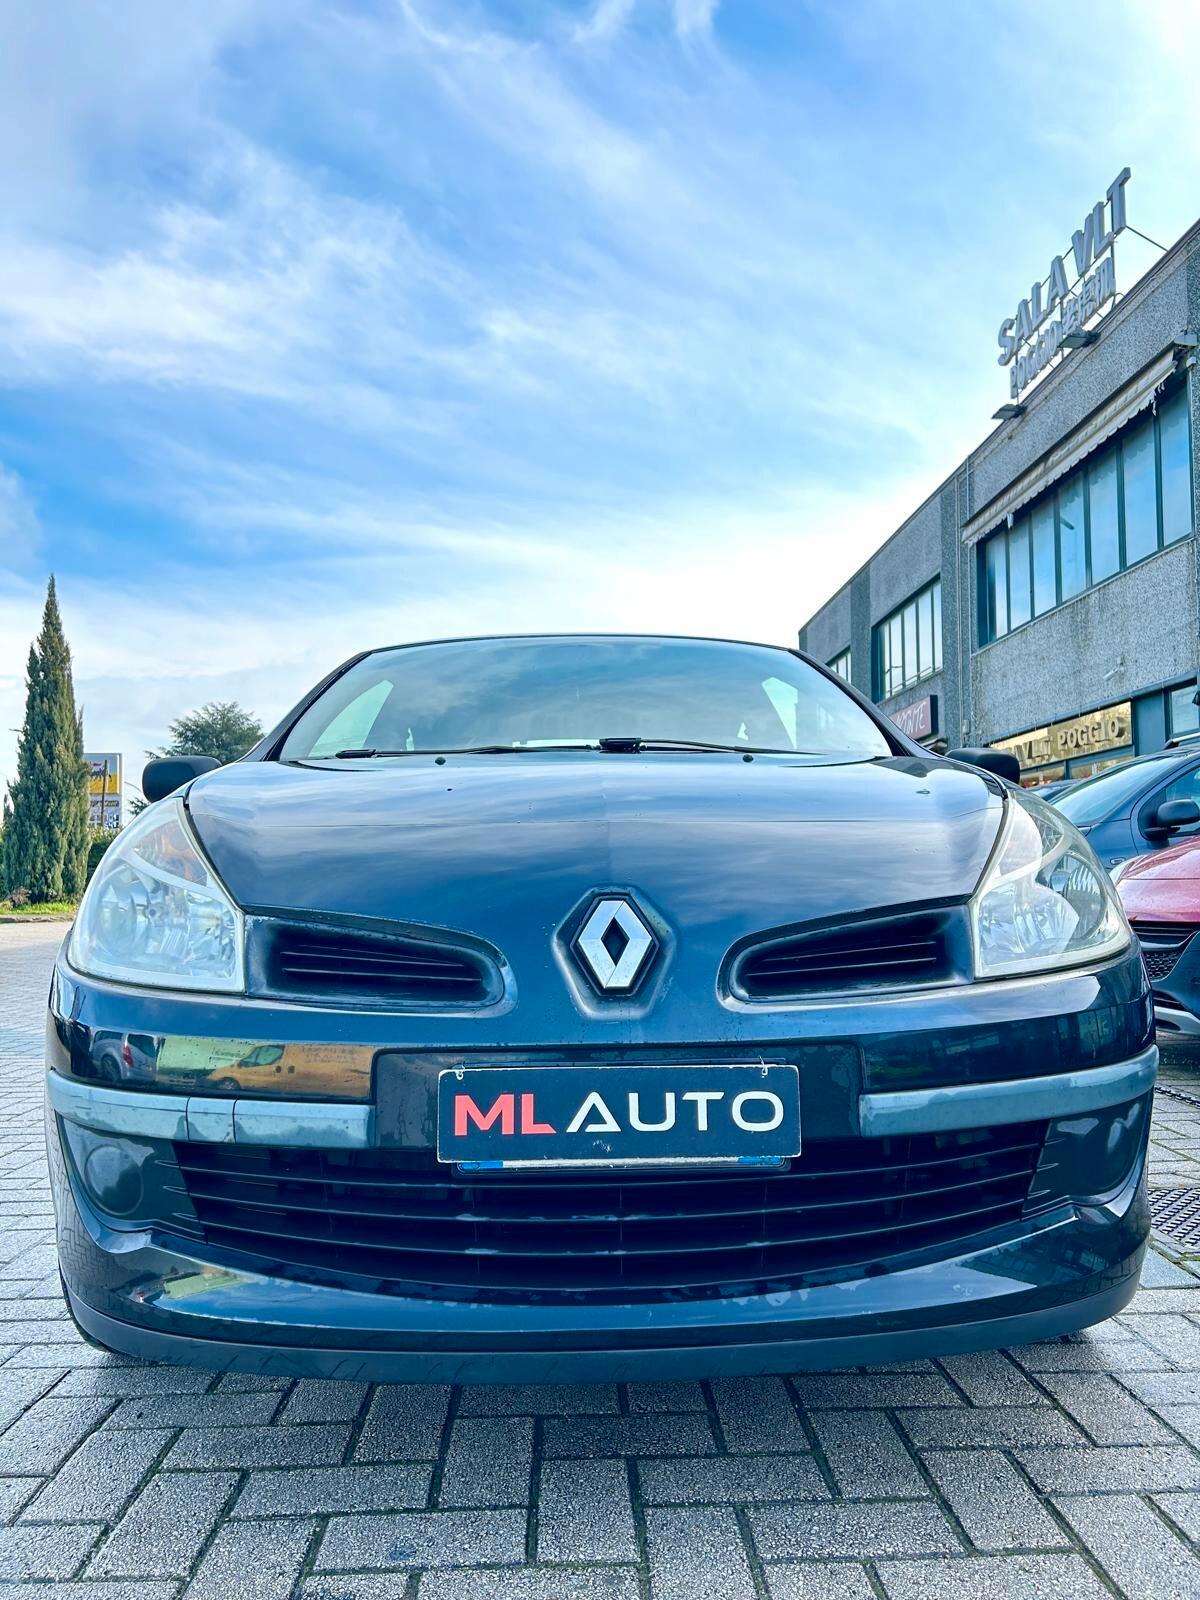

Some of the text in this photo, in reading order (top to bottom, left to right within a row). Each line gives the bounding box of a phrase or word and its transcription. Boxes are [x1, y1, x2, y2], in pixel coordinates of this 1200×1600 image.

[998, 167, 1131, 366] SALA VLT
[1010, 321, 1061, 399] POGGIO
[1057, 717, 1123, 750] POGGIO
